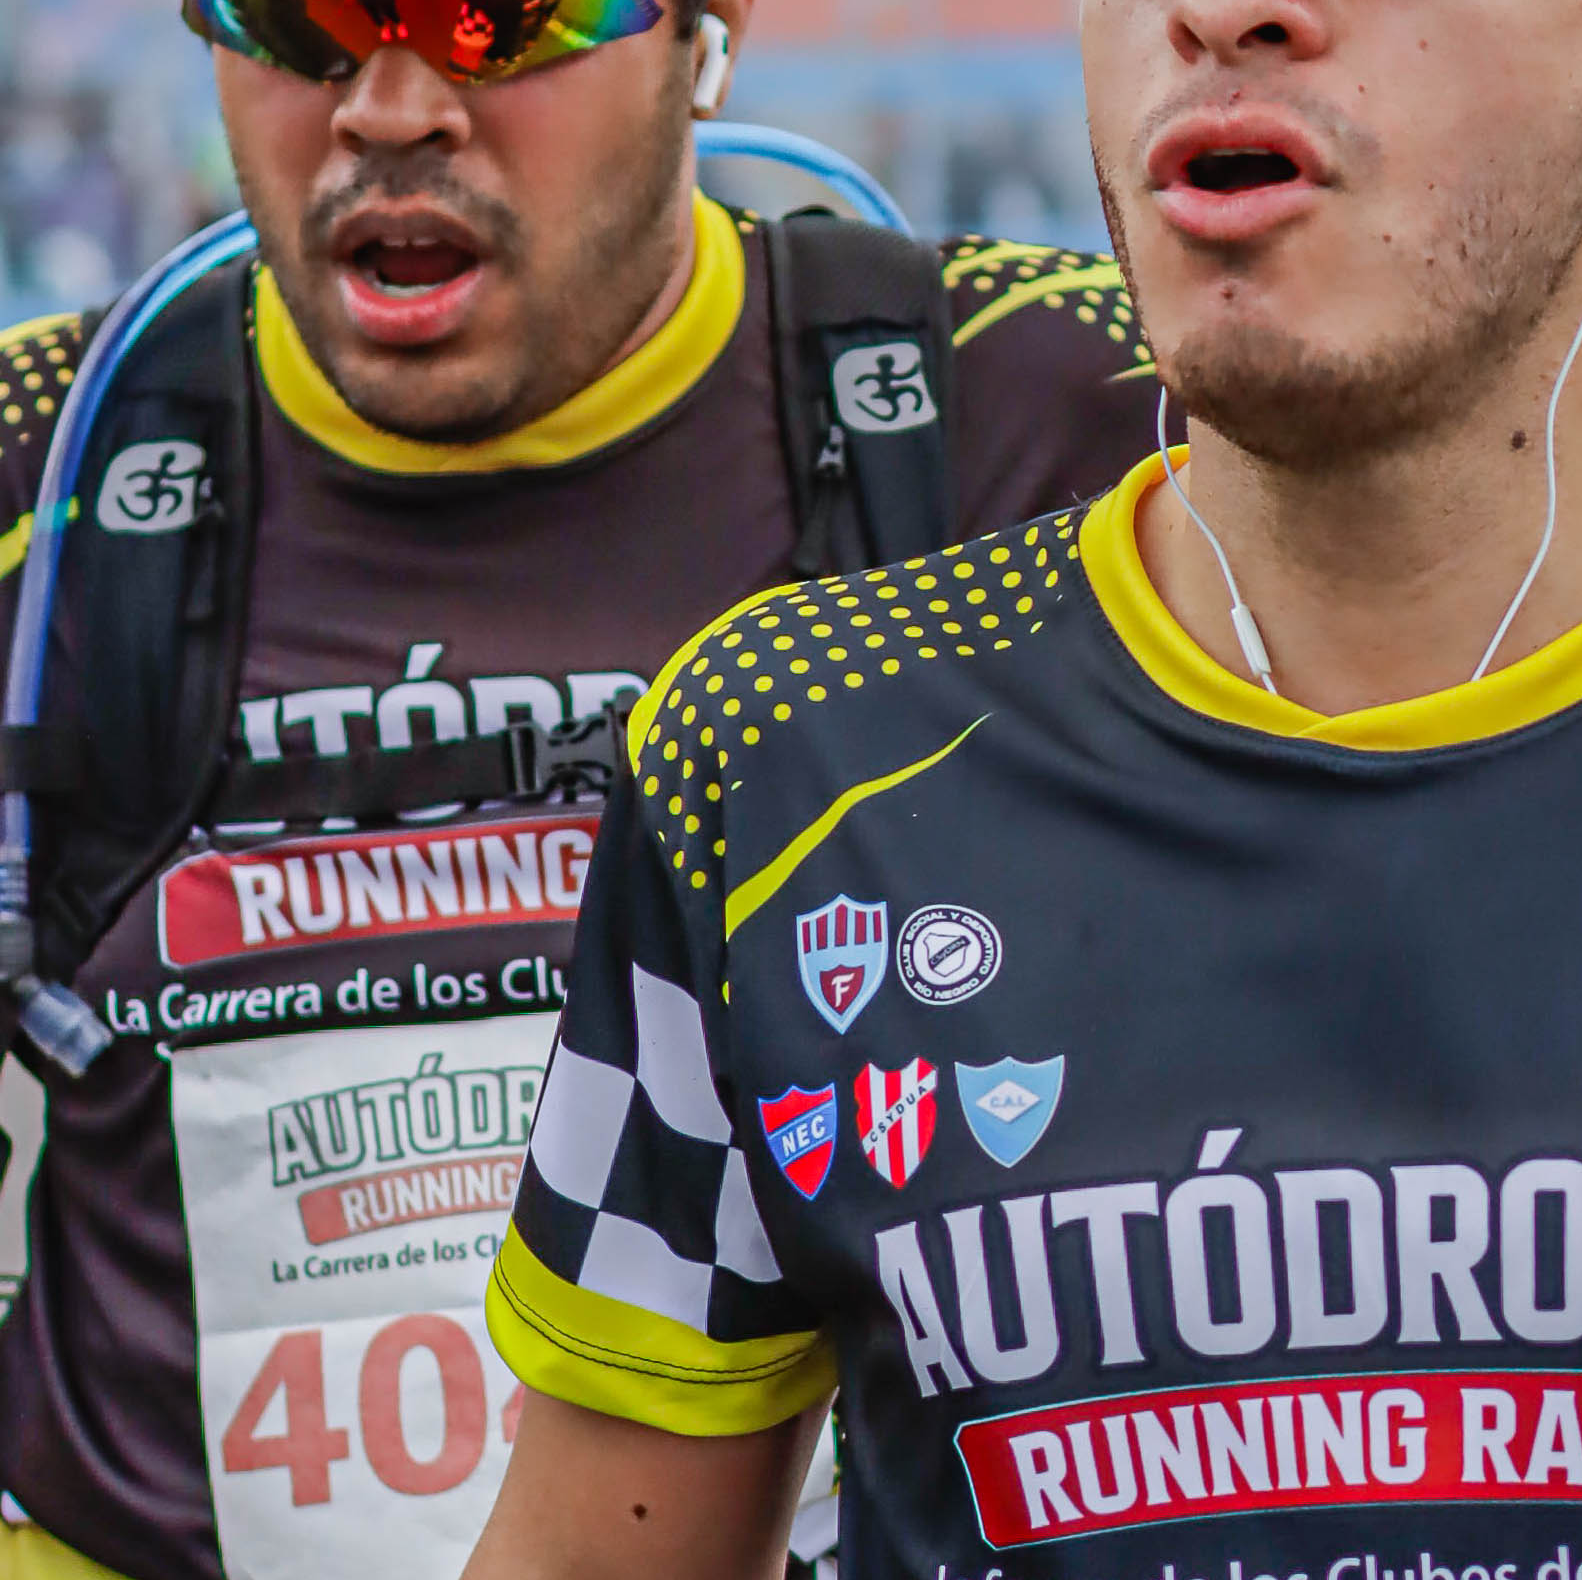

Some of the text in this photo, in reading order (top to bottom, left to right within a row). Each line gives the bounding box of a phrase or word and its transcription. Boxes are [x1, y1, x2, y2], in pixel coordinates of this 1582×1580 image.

[230, 829, 594, 946] RUNNING
[905, 910, 948, 941] SOCIAL
[950, 911, 960, 920] Y
[961, 915, 994, 975] DEPORTIVO
[106, 988, 151, 1035] La
[158, 982, 323, 1032] Carrera
[337, 967, 401, 1014] de
[414, 962, 488, 1009] los
[831, 973, 855, 1008] F
[934, 977, 980, 1000] NEGRO
[268, 1051, 545, 1188] AUTÓDR
[780, 1113, 827, 1159] NEC
[340, 1161, 517, 1231] RUNNING
[272, 1260, 299, 1283] La
[303, 1251, 390, 1280] Carrera
[396, 1242, 427, 1267] de
[433, 1239, 467, 1263] los
[221, 1312, 526, 1508] 40
[1008, 1387, 1428, 1530] RUNNING
